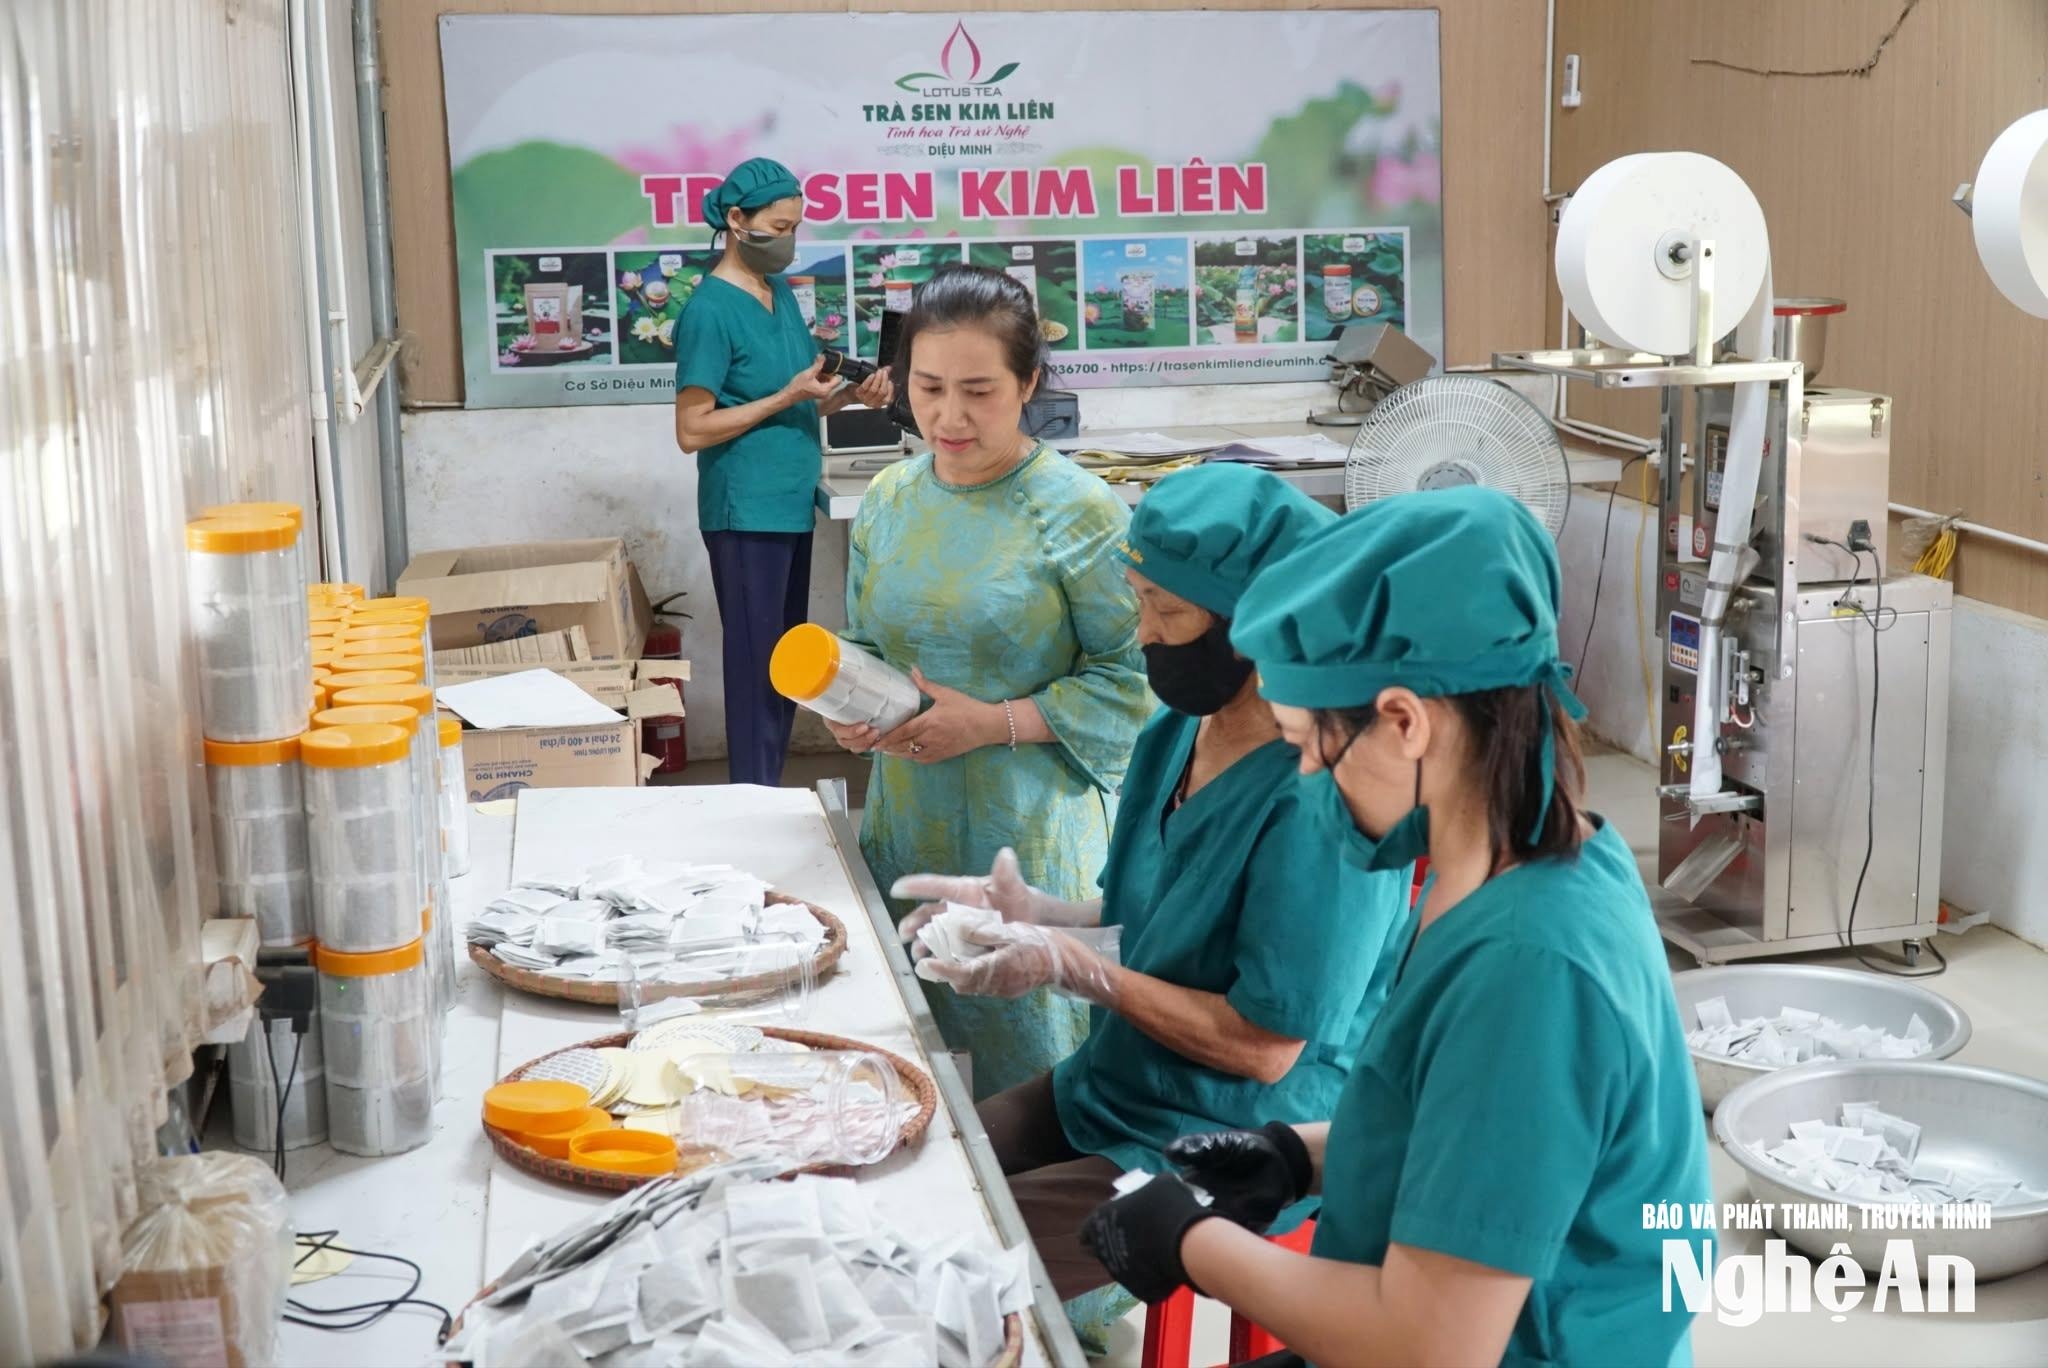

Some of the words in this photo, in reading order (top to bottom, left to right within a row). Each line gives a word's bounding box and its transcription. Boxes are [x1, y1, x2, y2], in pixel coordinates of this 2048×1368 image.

[923, 87, 970, 98] LOTUS
[974, 87, 1003, 97] TEA
[863, 101, 906, 122] TRÀ
[911, 103, 951, 121] SEN
[958, 102, 1000, 121] KIM
[1007, 99, 1054, 120] LIÊN
[886, 126, 915, 139] Tinh
[918, 126, 943, 138] hoa
[948, 126, 971, 138] Trà
[928, 142, 956, 158] DIỆU
[959, 144, 992, 156] MINH
[803, 172, 934, 220] SEN
[960, 168, 1096, 218] KIM
[1118, 157, 1265, 215] LIÊN
[1110, 356, 1327, 374] https://trasenkimliendieuminh.c
[564, 380, 586, 391] Cơ
[590, 378, 608, 390] Sở
[612, 378, 645, 392] Diệu
[649, 378, 676, 389] Min
[539, 736, 566, 749] g/chai
[567, 737, 584, 746] 400
[591, 735, 609, 744] chai
[610, 734, 621, 743] 24
[475, 773, 494, 781] 100
[496, 770, 534, 780] CHANH
